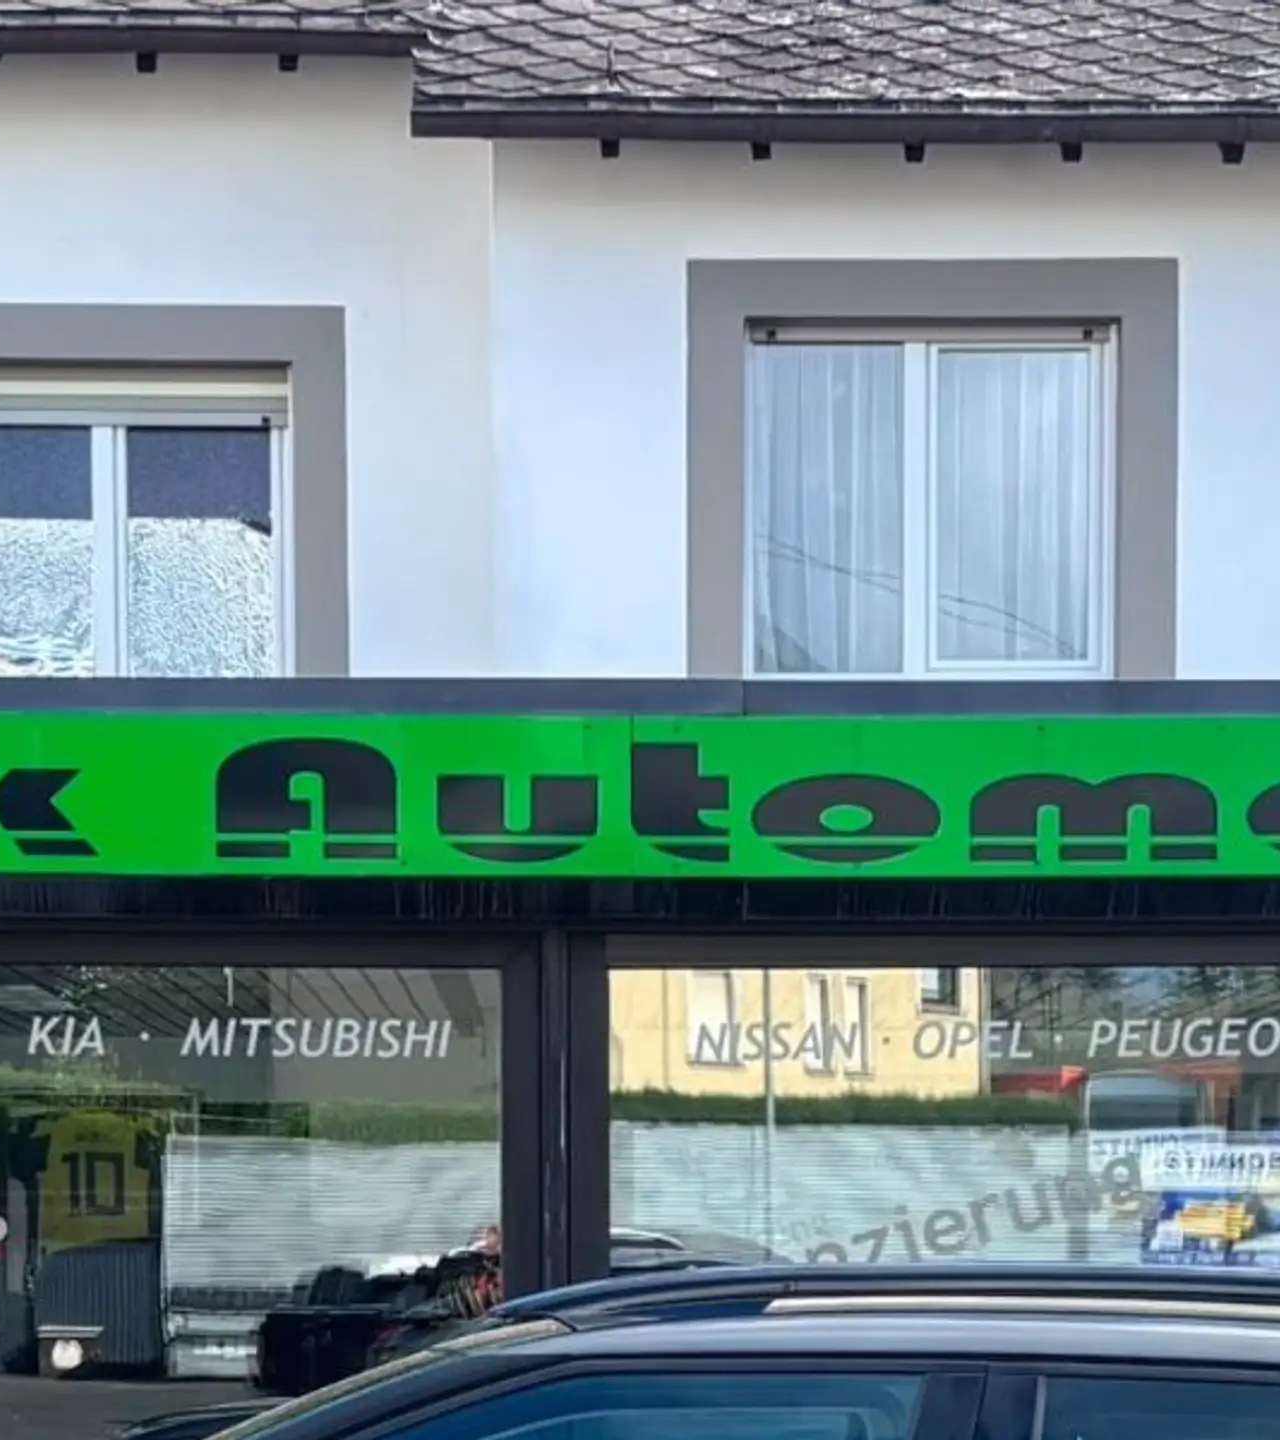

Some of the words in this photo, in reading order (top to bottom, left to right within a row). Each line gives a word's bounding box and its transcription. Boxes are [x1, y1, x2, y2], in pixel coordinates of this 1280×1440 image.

[27, 1016, 106, 1056] KIA
[179, 1018, 452, 1058] MITSUBISHI
[695, 1021, 860, 1062] NISSAN
[912, 1020, 1034, 1061] OPEL
